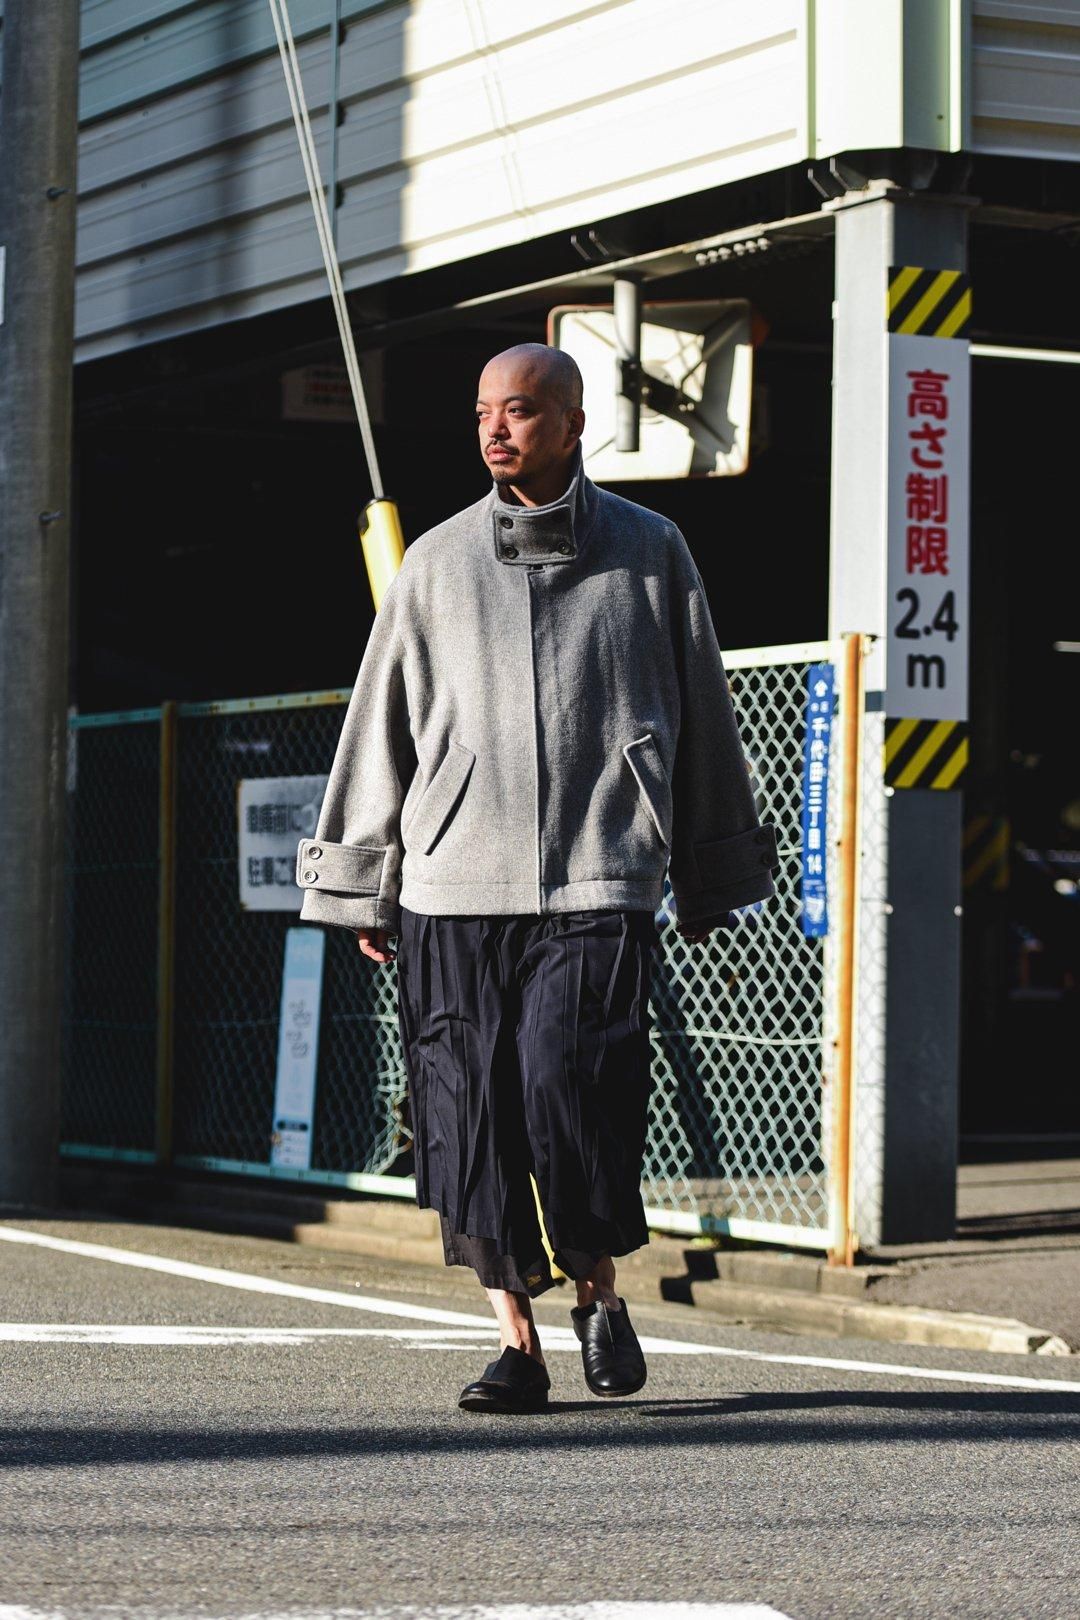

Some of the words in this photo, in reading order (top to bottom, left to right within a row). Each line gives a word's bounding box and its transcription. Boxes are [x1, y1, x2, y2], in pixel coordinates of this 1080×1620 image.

[906, 369, 949, 576] 高さ制限
[894, 588, 959, 642] 2.4
[906, 653, 945, 689] m
